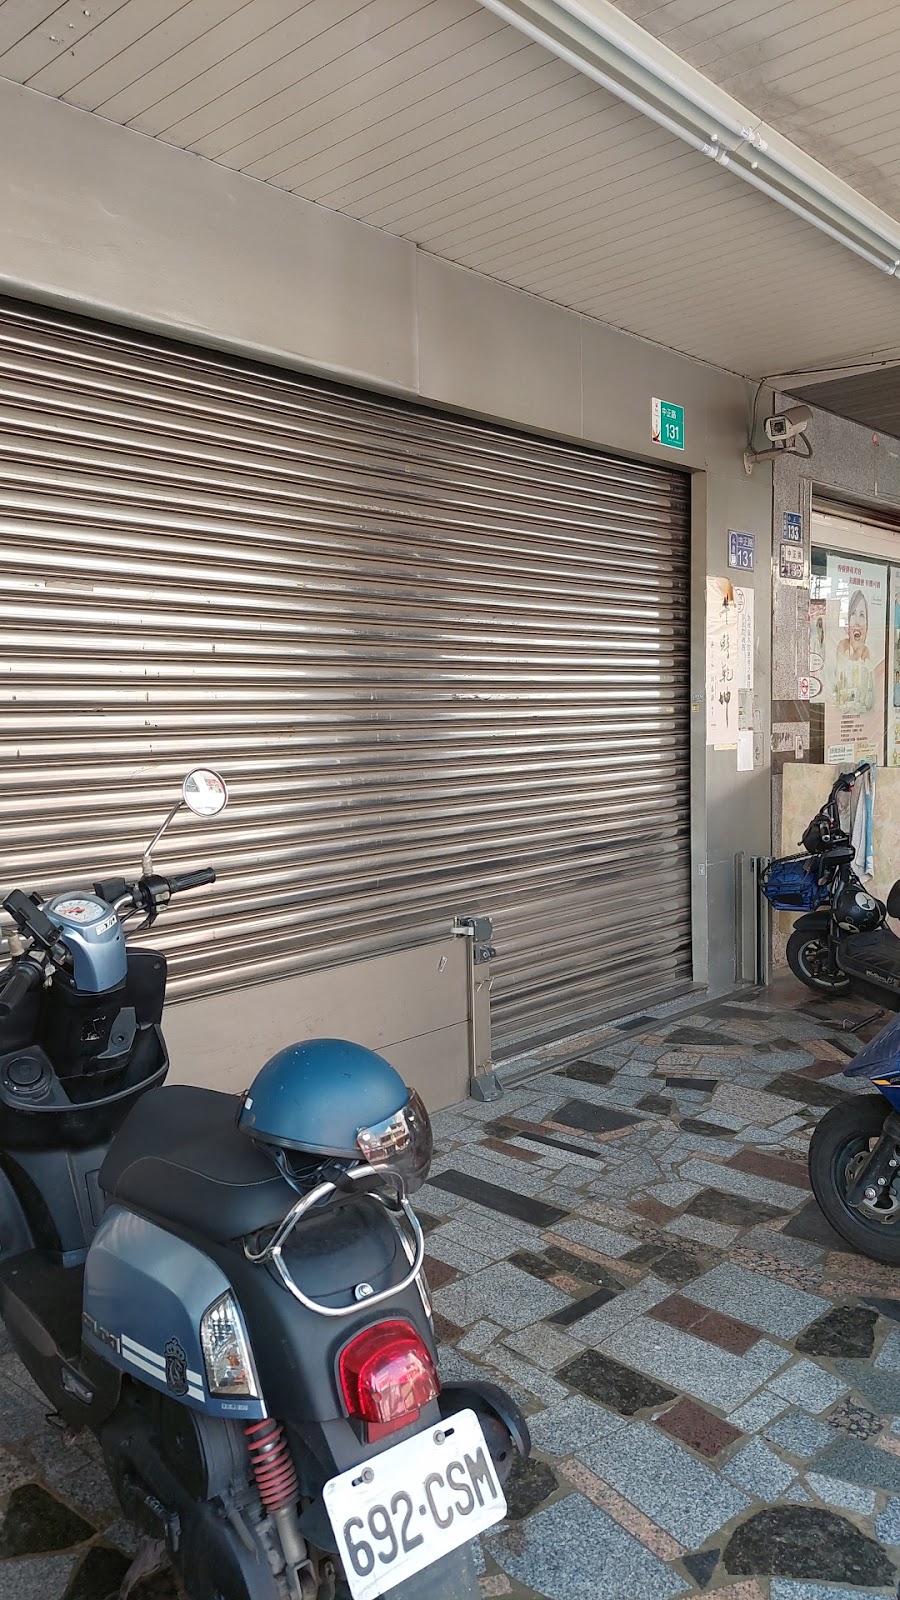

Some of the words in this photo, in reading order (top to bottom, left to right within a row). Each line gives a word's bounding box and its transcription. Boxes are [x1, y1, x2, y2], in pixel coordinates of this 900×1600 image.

[665, 423, 679, 441] 131
[787, 524, 799, 541] 133
[738, 536, 753, 548] 中正路
[737, 549, 753, 568] 131
[787, 562, 802, 578] 133
